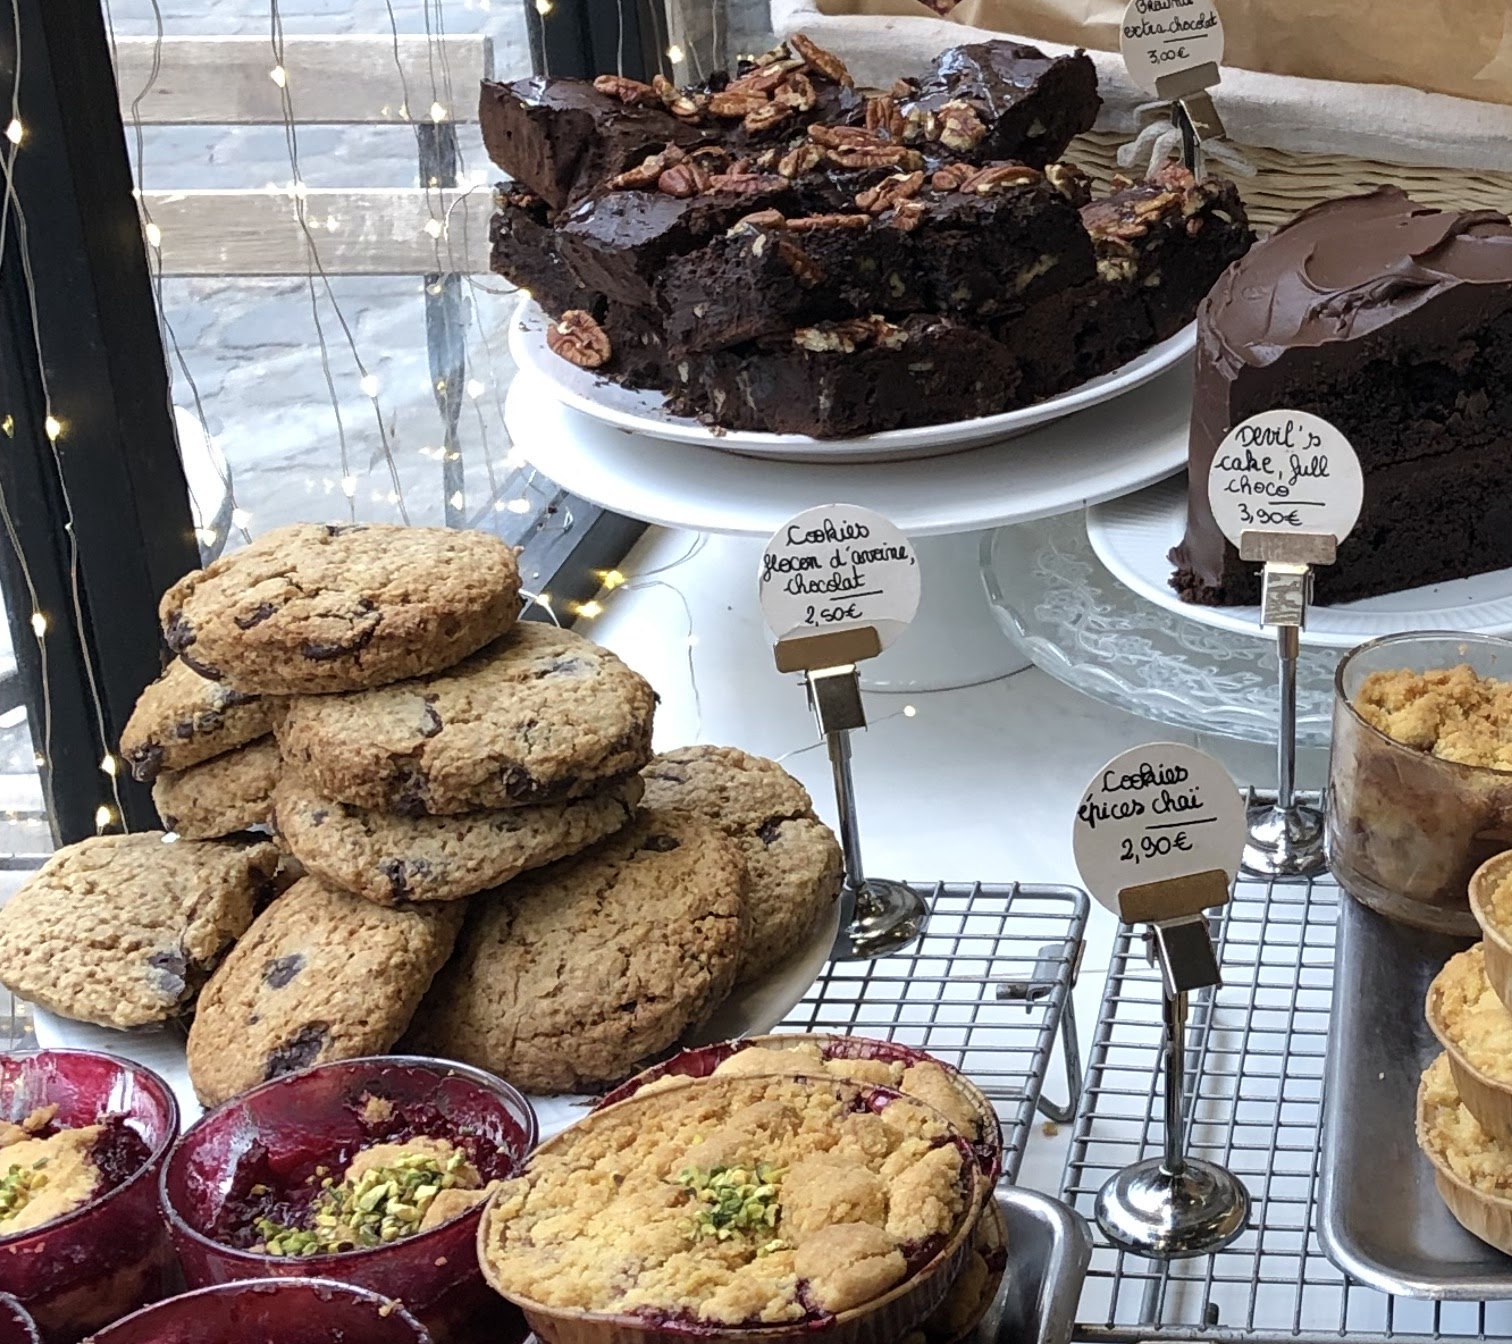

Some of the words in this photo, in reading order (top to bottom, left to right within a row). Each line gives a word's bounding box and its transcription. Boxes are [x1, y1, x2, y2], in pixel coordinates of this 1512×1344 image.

[1124, 17, 1165, 38] extra
[1166, 11, 1218, 34] chocolat
[1235, 420, 1322, 450] Devil's
[1214, 449, 1283, 480] cake,
[1288, 454, 1330, 487] full
[1224, 475, 1290, 497] choco
[1238, 503, 1303, 526] 3,90€
[785, 518, 870, 547] Cookies
[783, 565, 866, 595] chocolat
[804, 603, 863, 627] 2,50€
[1101, 762, 1189, 793] Cookies
[1077, 793, 1145, 829] épices
[1151, 786, 1204, 815] chaï
[1120, 831, 1193, 864] 2,90€
